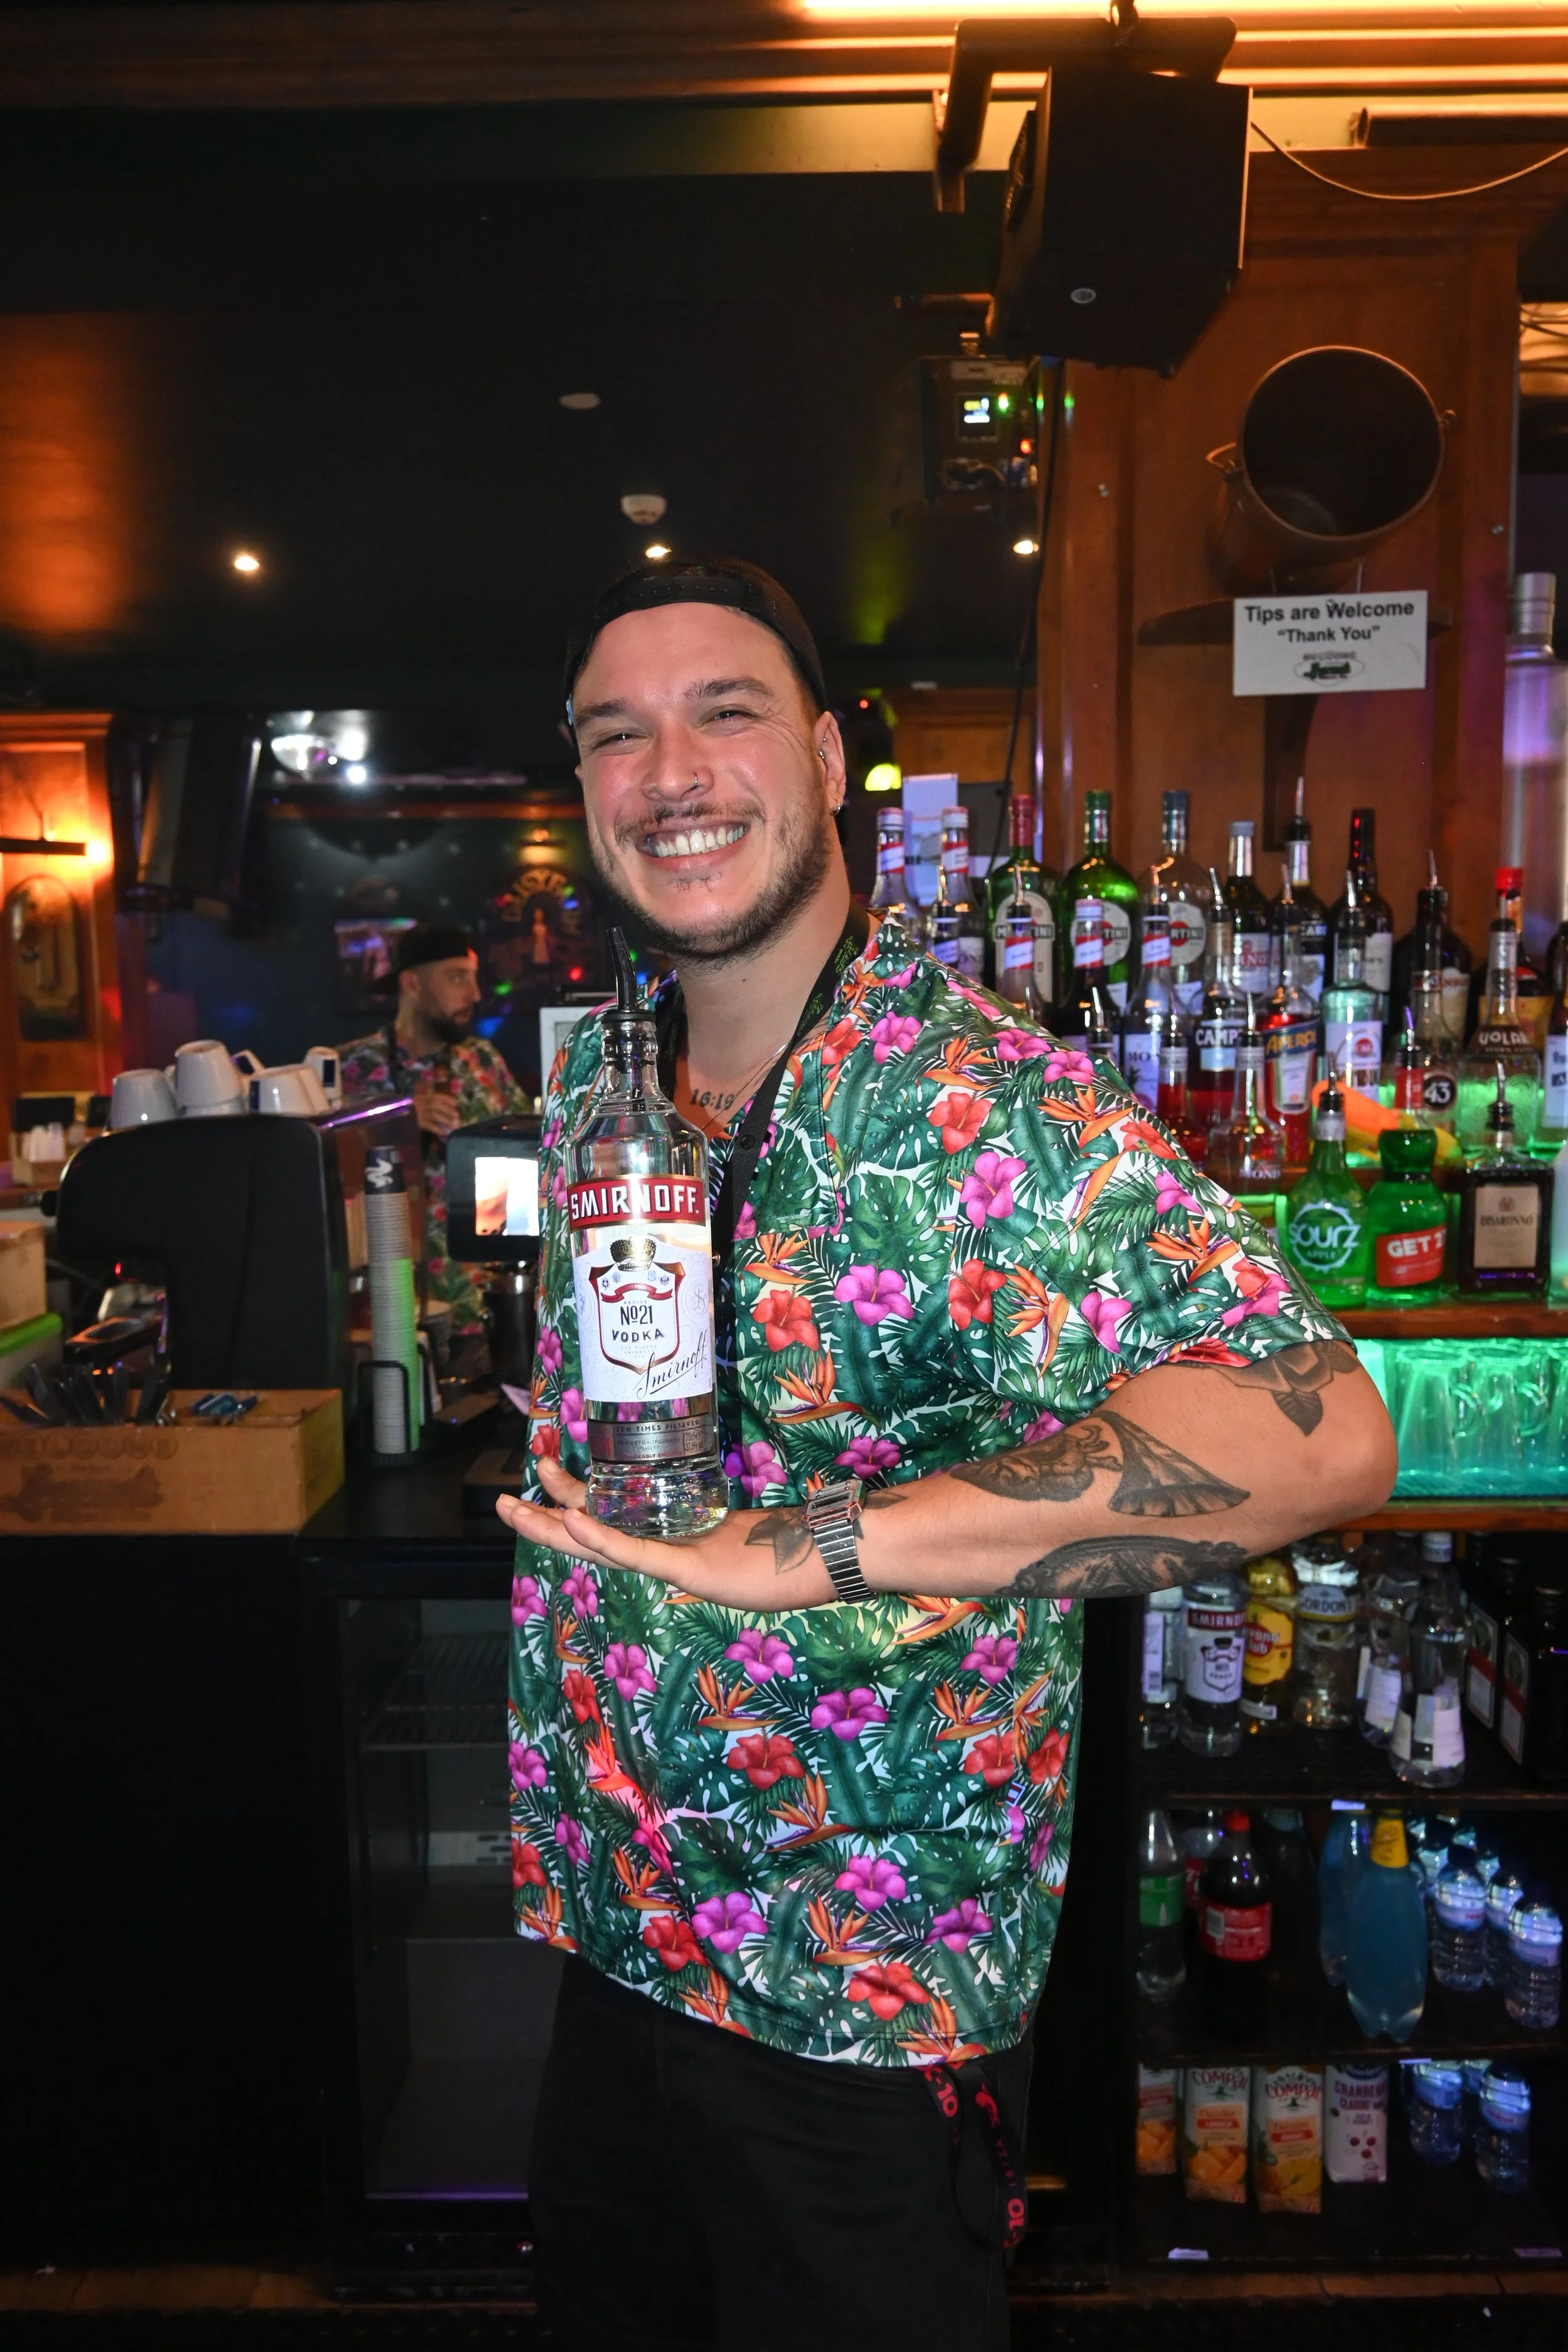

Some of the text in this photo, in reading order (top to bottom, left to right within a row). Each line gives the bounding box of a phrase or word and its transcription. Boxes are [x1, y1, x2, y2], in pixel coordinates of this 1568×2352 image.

[1245, 600, 1414, 625] Tips are Welcome
[1424, 1081, 1451, 1099] 43
[570, 1184, 697, 1221] SMIRNOFF
[1387, 1236, 1433, 1258] GET
[612, 1328, 665, 1343] VODKA
[634, 1328, 709, 1399] Smirnoff
[635, 1424, 662, 1433] TIMES
[665, 1419, 701, 1431] FILTERED
